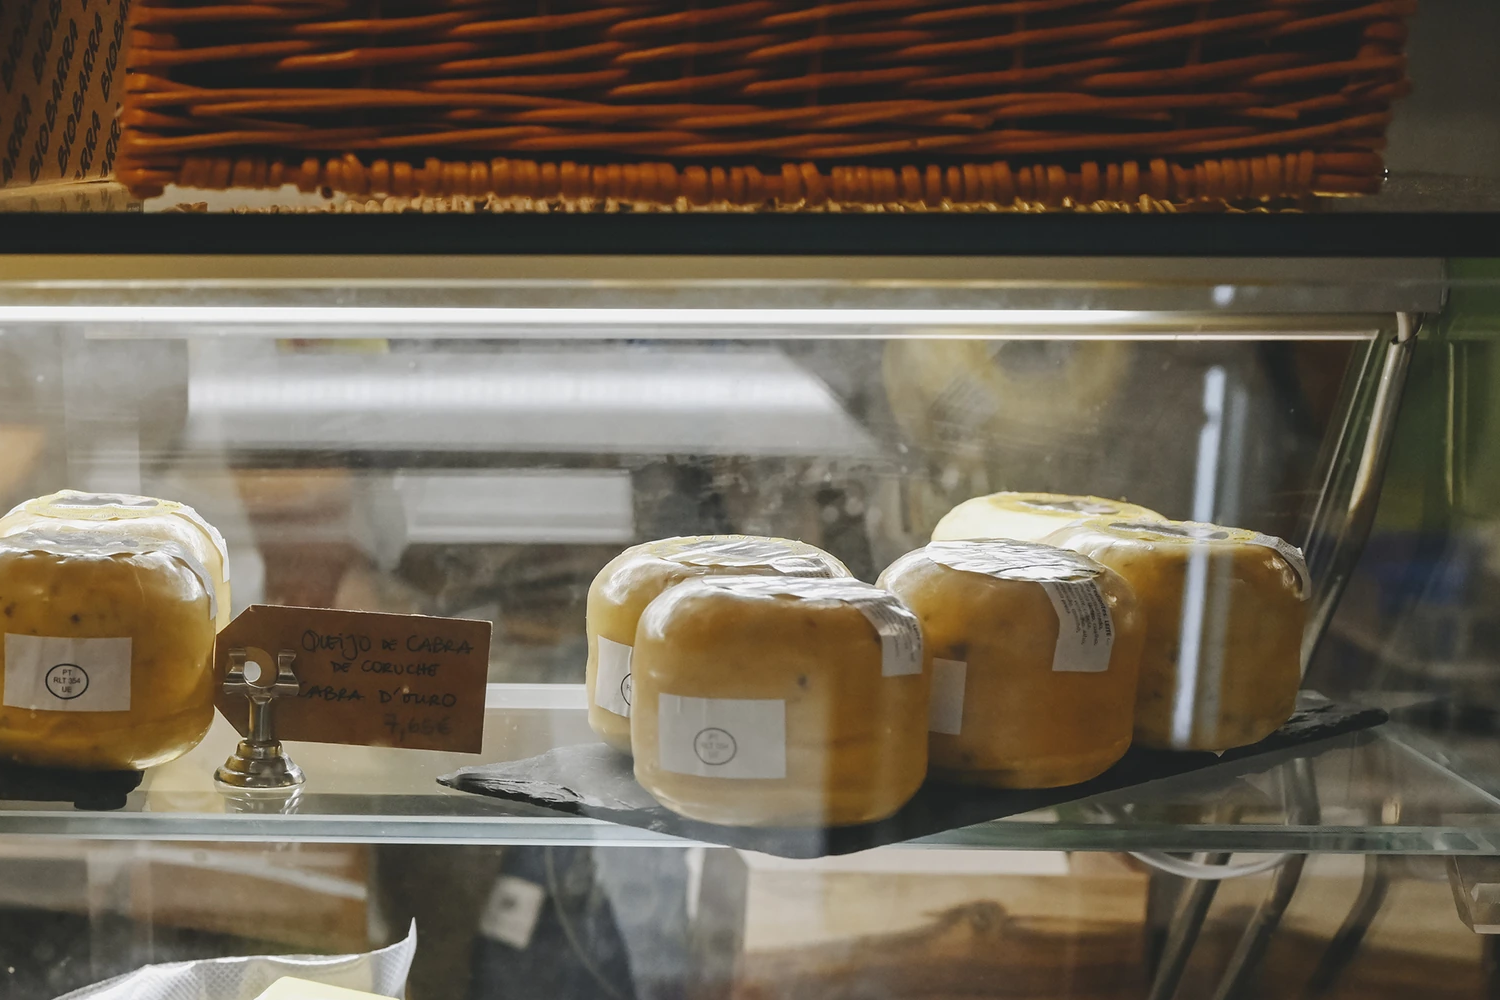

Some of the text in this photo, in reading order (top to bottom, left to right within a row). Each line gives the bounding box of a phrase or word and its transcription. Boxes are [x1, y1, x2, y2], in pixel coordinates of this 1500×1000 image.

[29, 18, 78, 184] BIOBARRA
[58, 12, 103, 178] BIOBARRA
[302, 629, 474, 661] QUEIJO DE CABRA
[331, 660, 440, 677] DE CORUCHE
[297, 683, 365, 701] CABRA
